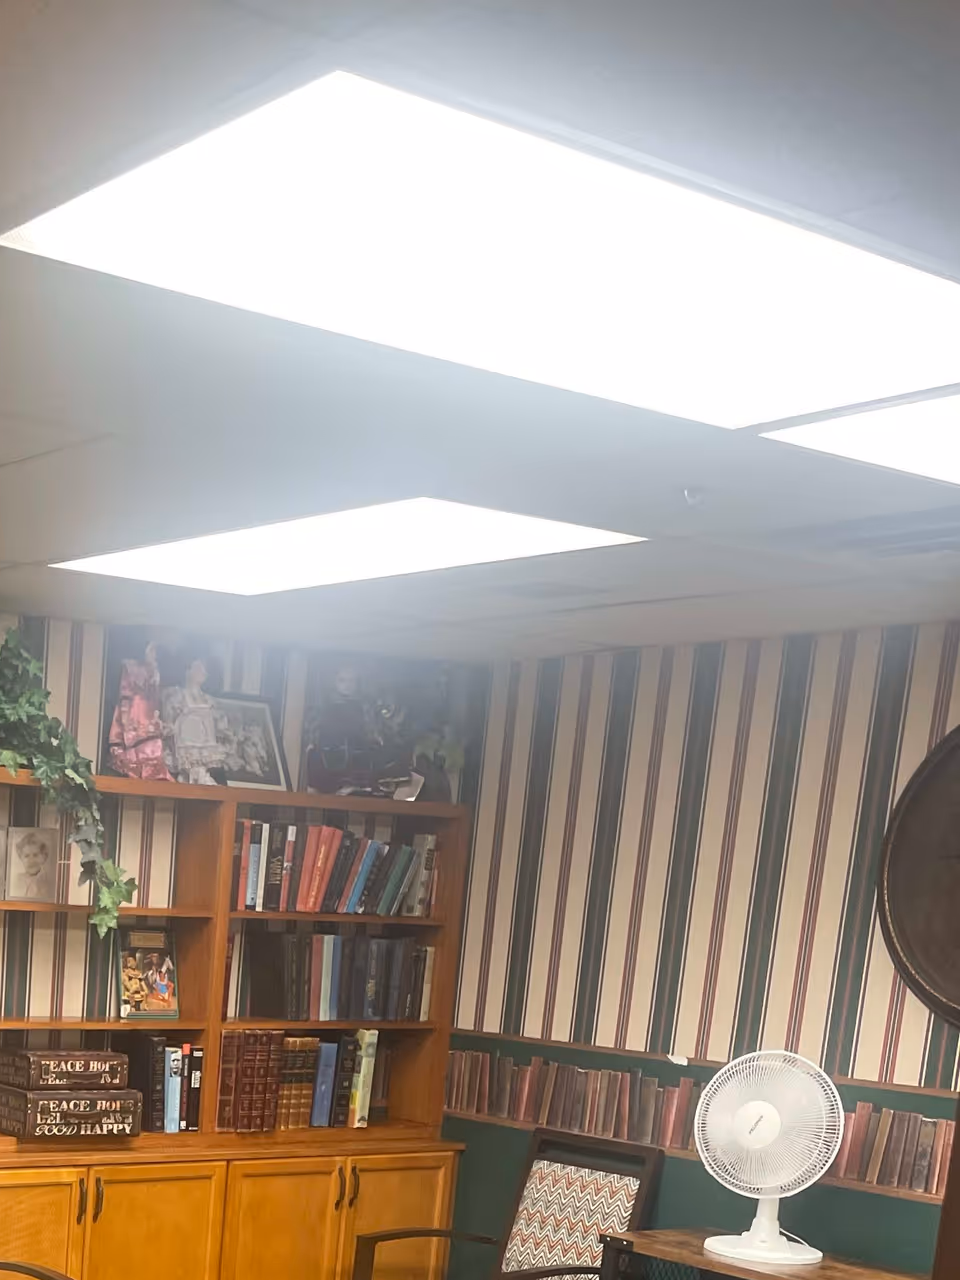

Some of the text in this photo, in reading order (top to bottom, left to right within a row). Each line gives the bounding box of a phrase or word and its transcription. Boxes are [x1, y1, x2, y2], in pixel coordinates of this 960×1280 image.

[89, 1060, 121, 1072] HO
[96, 1100, 134, 1112] HO
[34, 1123, 133, 1136] GOOD HAPPY
